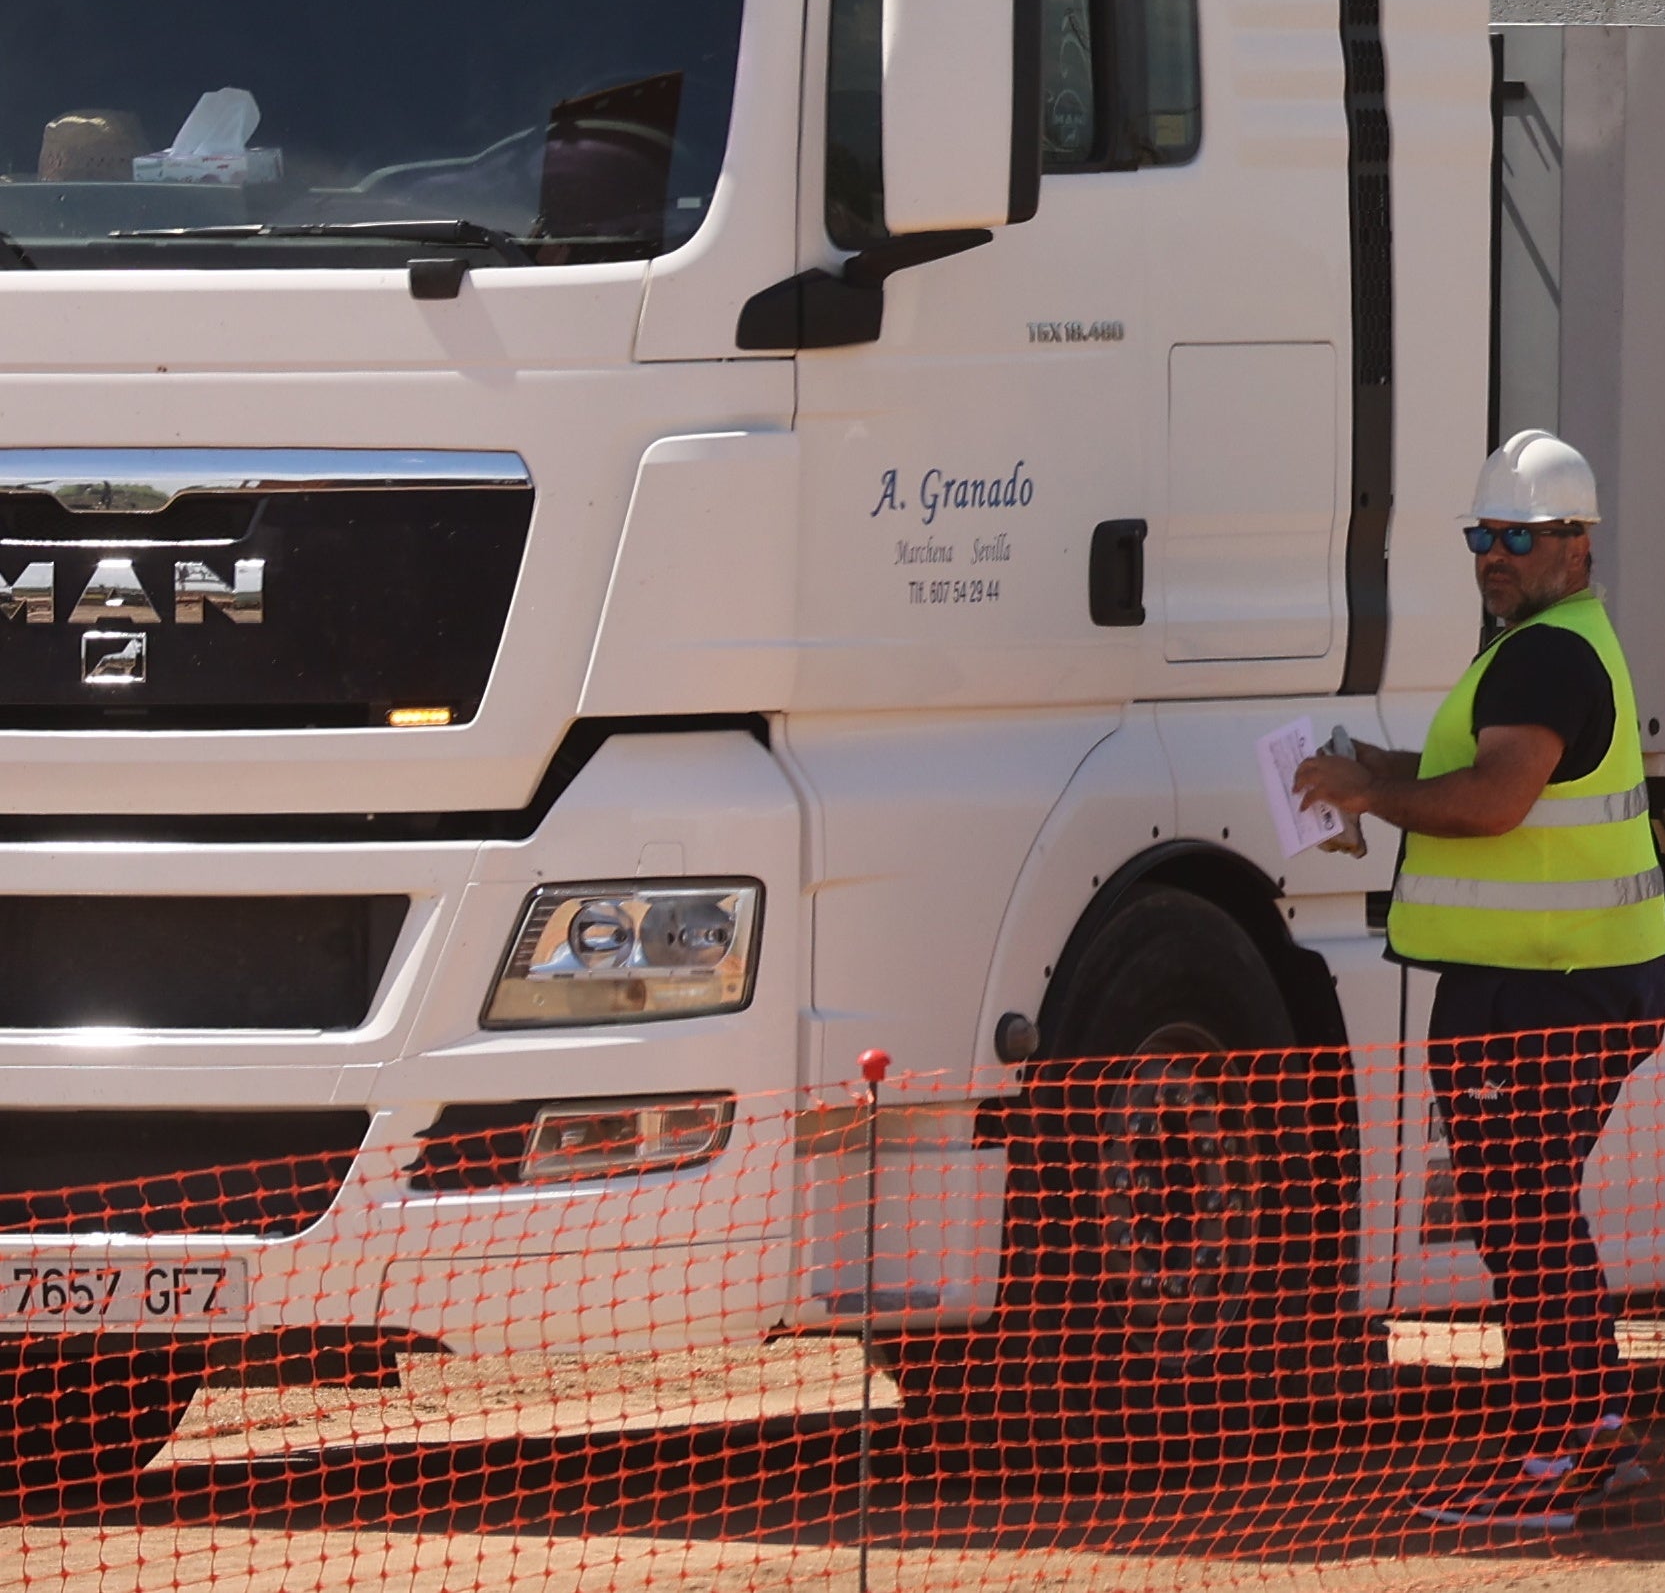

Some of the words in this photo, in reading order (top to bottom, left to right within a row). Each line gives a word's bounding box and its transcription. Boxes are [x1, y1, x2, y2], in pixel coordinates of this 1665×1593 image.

[870, 468, 906, 518] A.
[919, 459, 1034, 525] Granado
[970, 532, 1011, 565] Sevilla
[0, 559, 265, 624] MAN
[953, 579, 967, 603] 54
[986, 579, 999, 602] 44
[13, 1267, 121, 1316] 7657
[145, 1267, 227, 1315] GFZ
